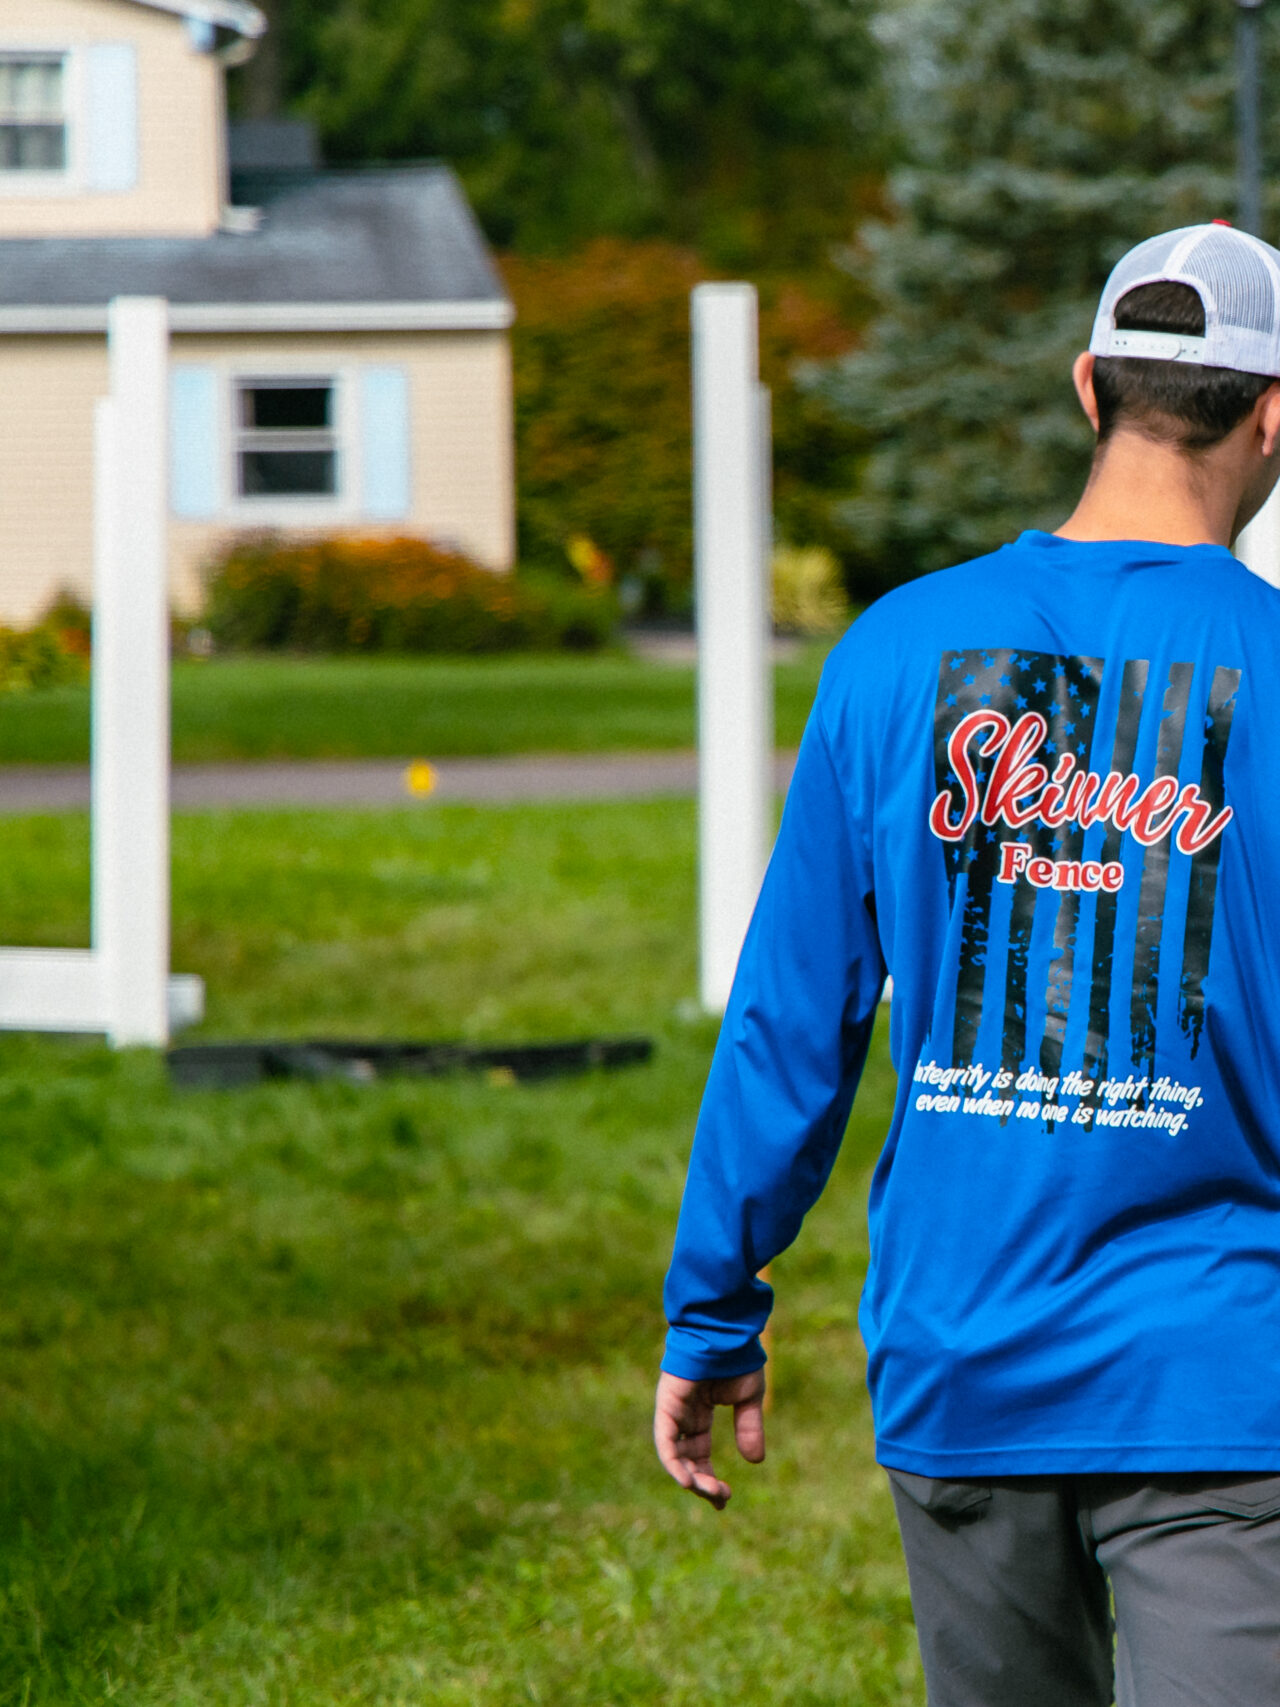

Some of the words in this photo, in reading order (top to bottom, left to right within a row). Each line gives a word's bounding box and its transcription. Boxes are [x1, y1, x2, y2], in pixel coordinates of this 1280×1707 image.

[929, 709, 1233, 855] Skinner
[997, 841, 1124, 890] Fence
[990, 1067, 1014, 1089] is
[1015, 1066, 1060, 1100] doing
[1060, 1070, 1095, 1097] the
[1096, 1074, 1149, 1107] right
[1148, 1076, 1204, 1111] thing,
[915, 1094, 961, 1112] even
[962, 1090, 1015, 1117] when
[1015, 1101, 1041, 1119] no
[1041, 1103, 1069, 1123] one
[1071, 1102, 1095, 1124] is
[1095, 1103, 1189, 1137] watching.
